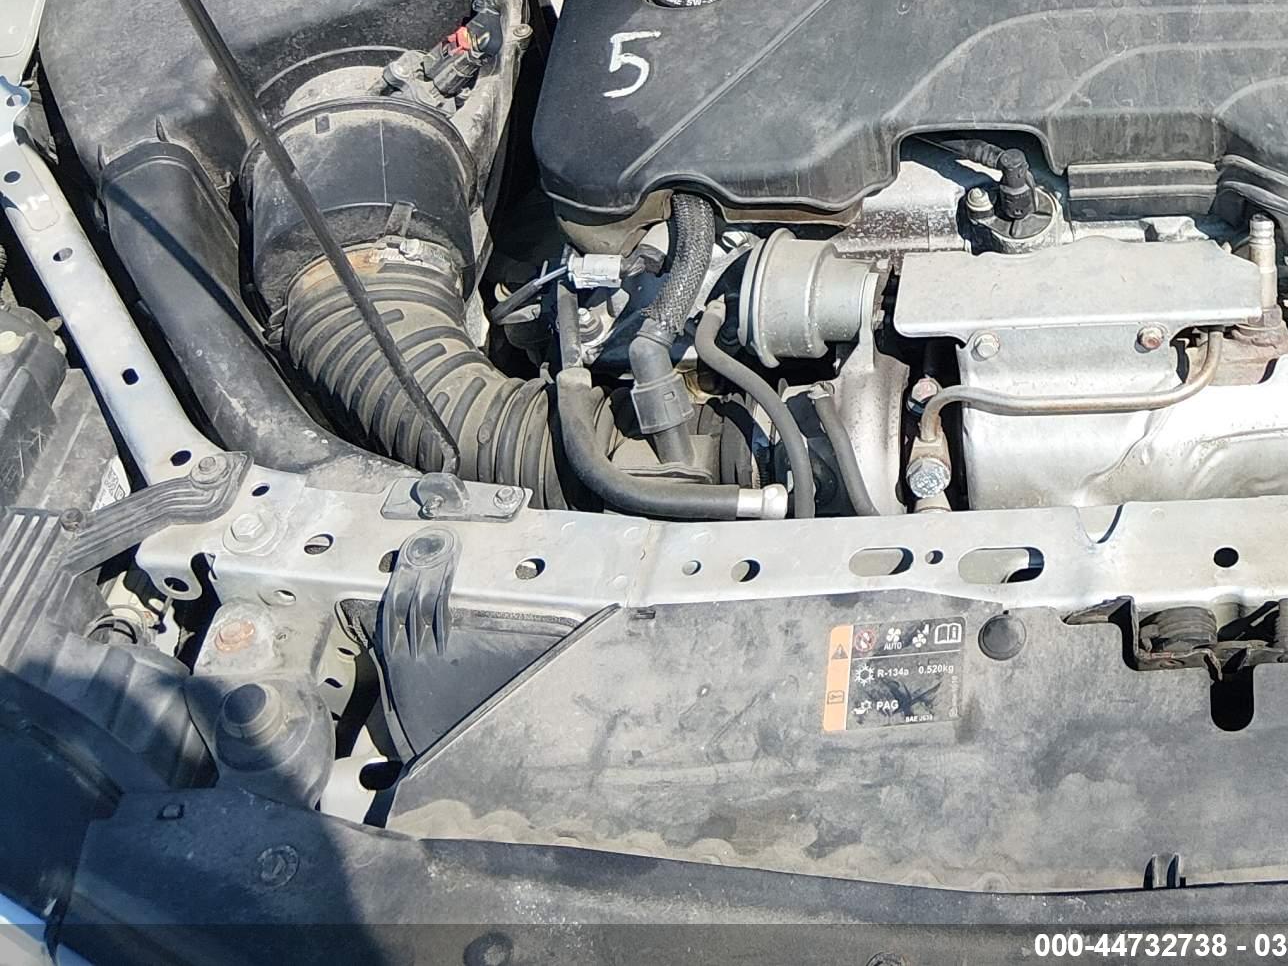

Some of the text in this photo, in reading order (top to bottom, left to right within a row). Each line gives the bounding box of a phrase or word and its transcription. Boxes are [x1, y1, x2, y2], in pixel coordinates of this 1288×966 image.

[603, 31, 662, 98] 5
[884, 642, 902, 651] AUTO
[877, 664, 954, 678] R-134a 0.520kg
[876, 699, 899, 710] PAG
